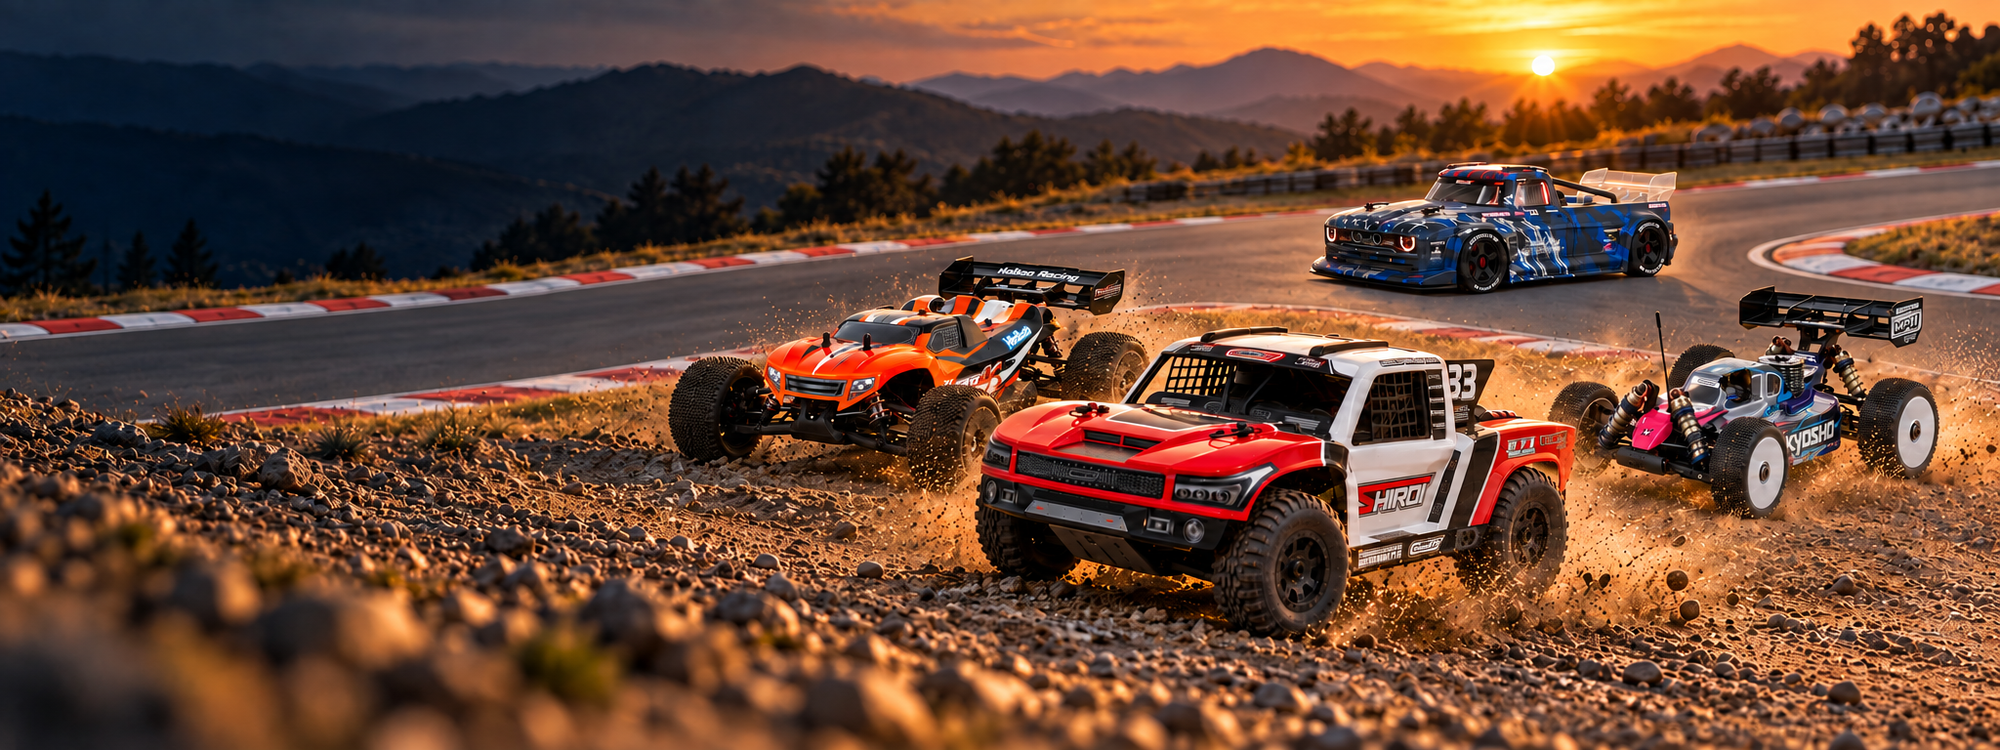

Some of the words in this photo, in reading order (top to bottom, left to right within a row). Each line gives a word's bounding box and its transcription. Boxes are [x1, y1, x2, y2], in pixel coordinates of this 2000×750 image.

[1037, 270, 1080, 282] Racing
[1448, 363, 1478, 401] 33
[1785, 419, 1835, 456] KYOSHO
